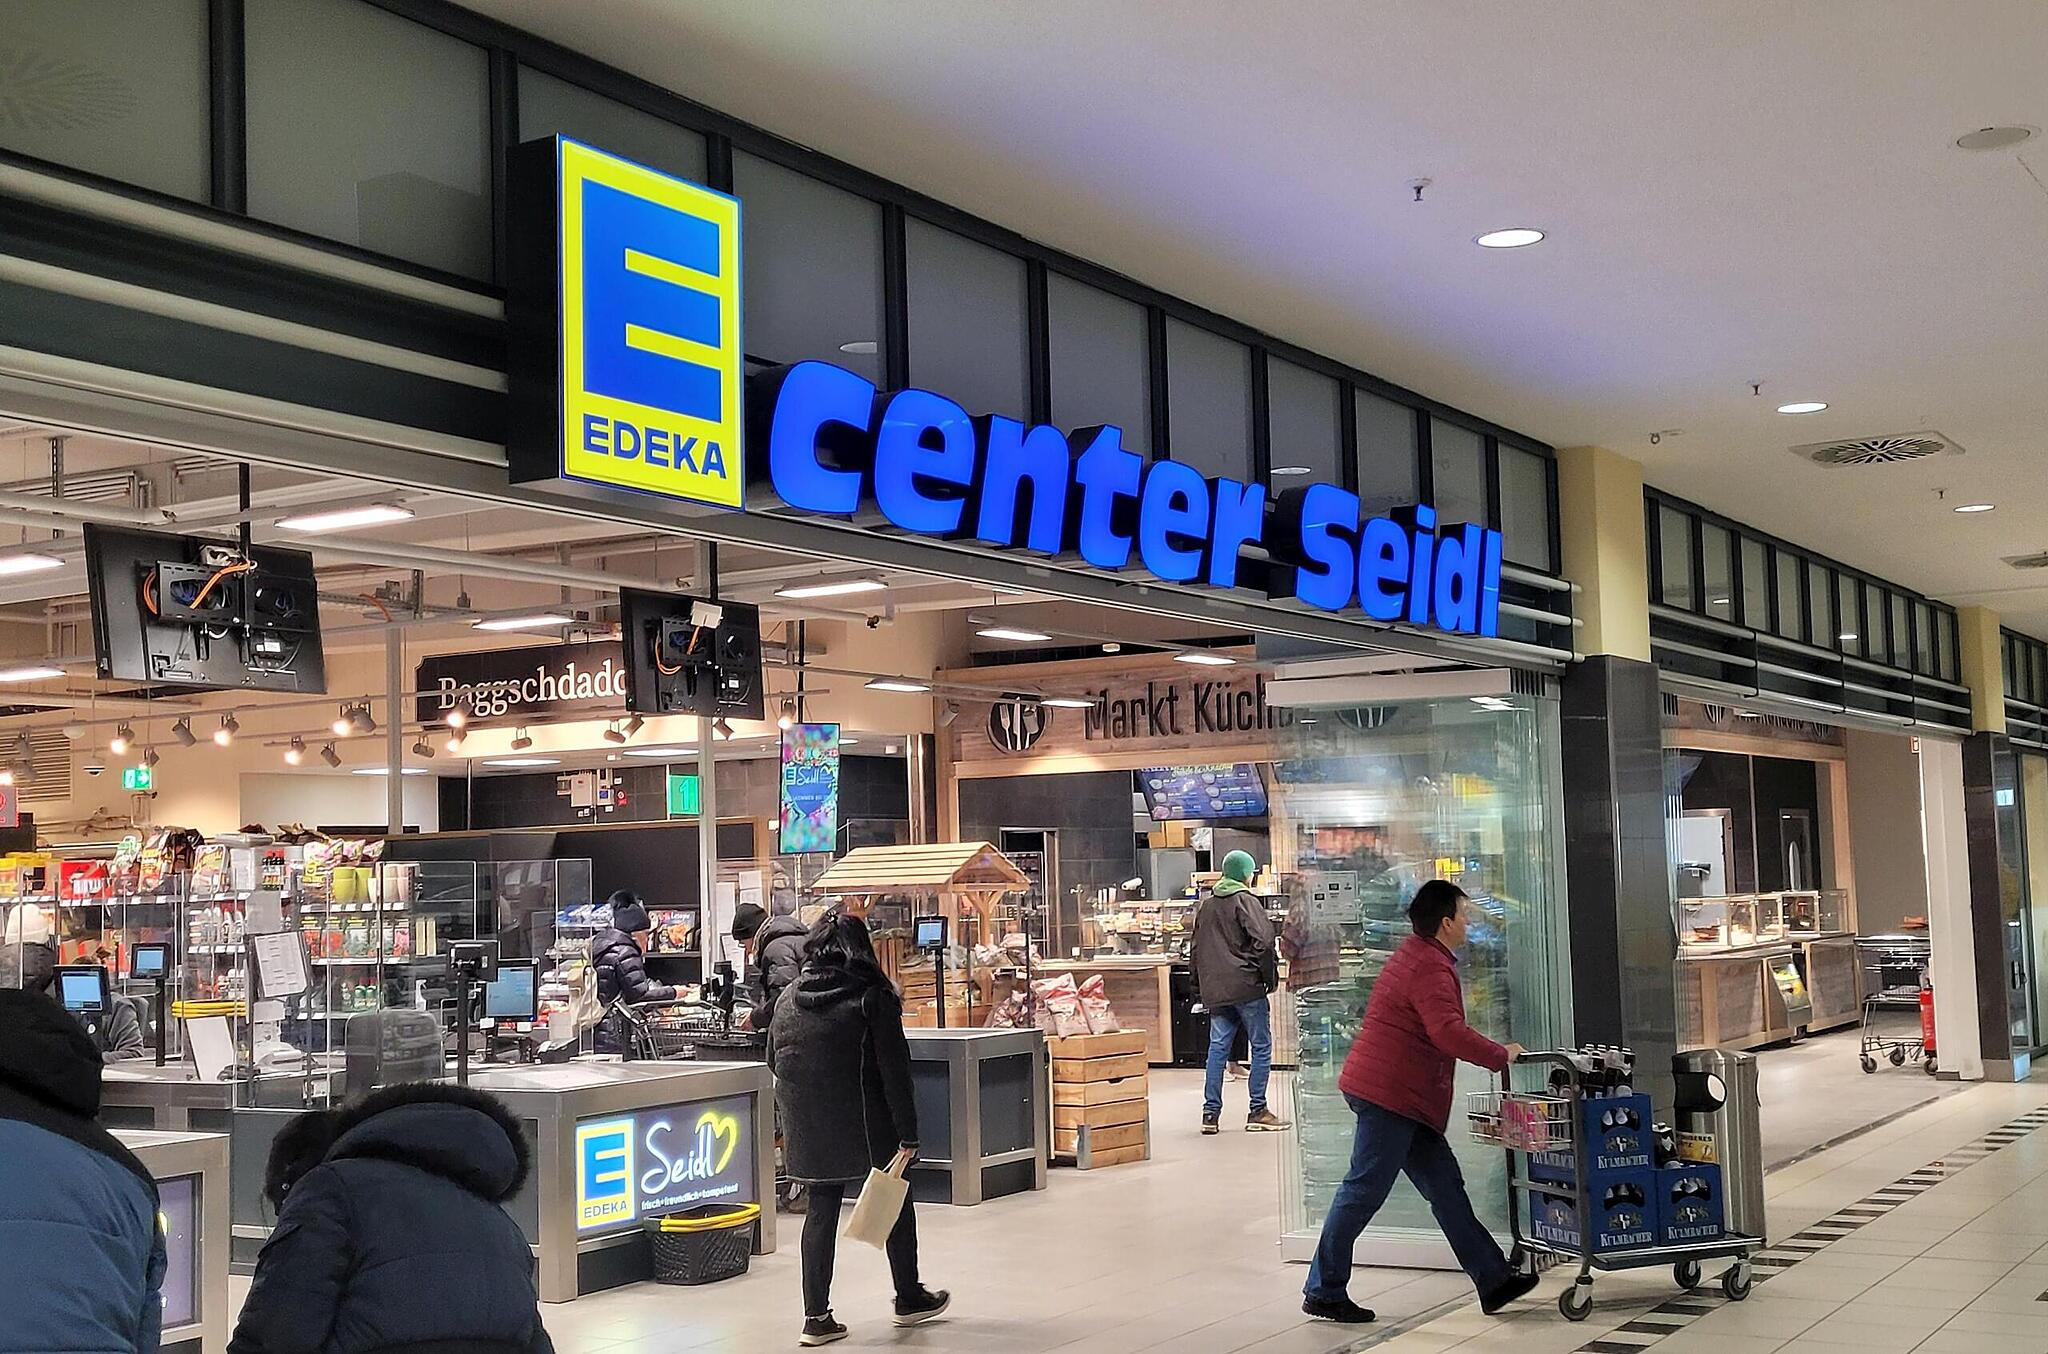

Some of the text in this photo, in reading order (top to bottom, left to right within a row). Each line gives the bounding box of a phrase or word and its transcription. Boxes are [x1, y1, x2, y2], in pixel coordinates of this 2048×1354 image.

[583, 412, 727, 480] EDEKA
[769, 359, 1503, 639] center Seidl
[1084, 680, 1183, 741] Markt
[680, 778, 691, 812] 1
[640, 1121, 715, 1194] Seidl
[584, 1200, 628, 1218] EDEKA
